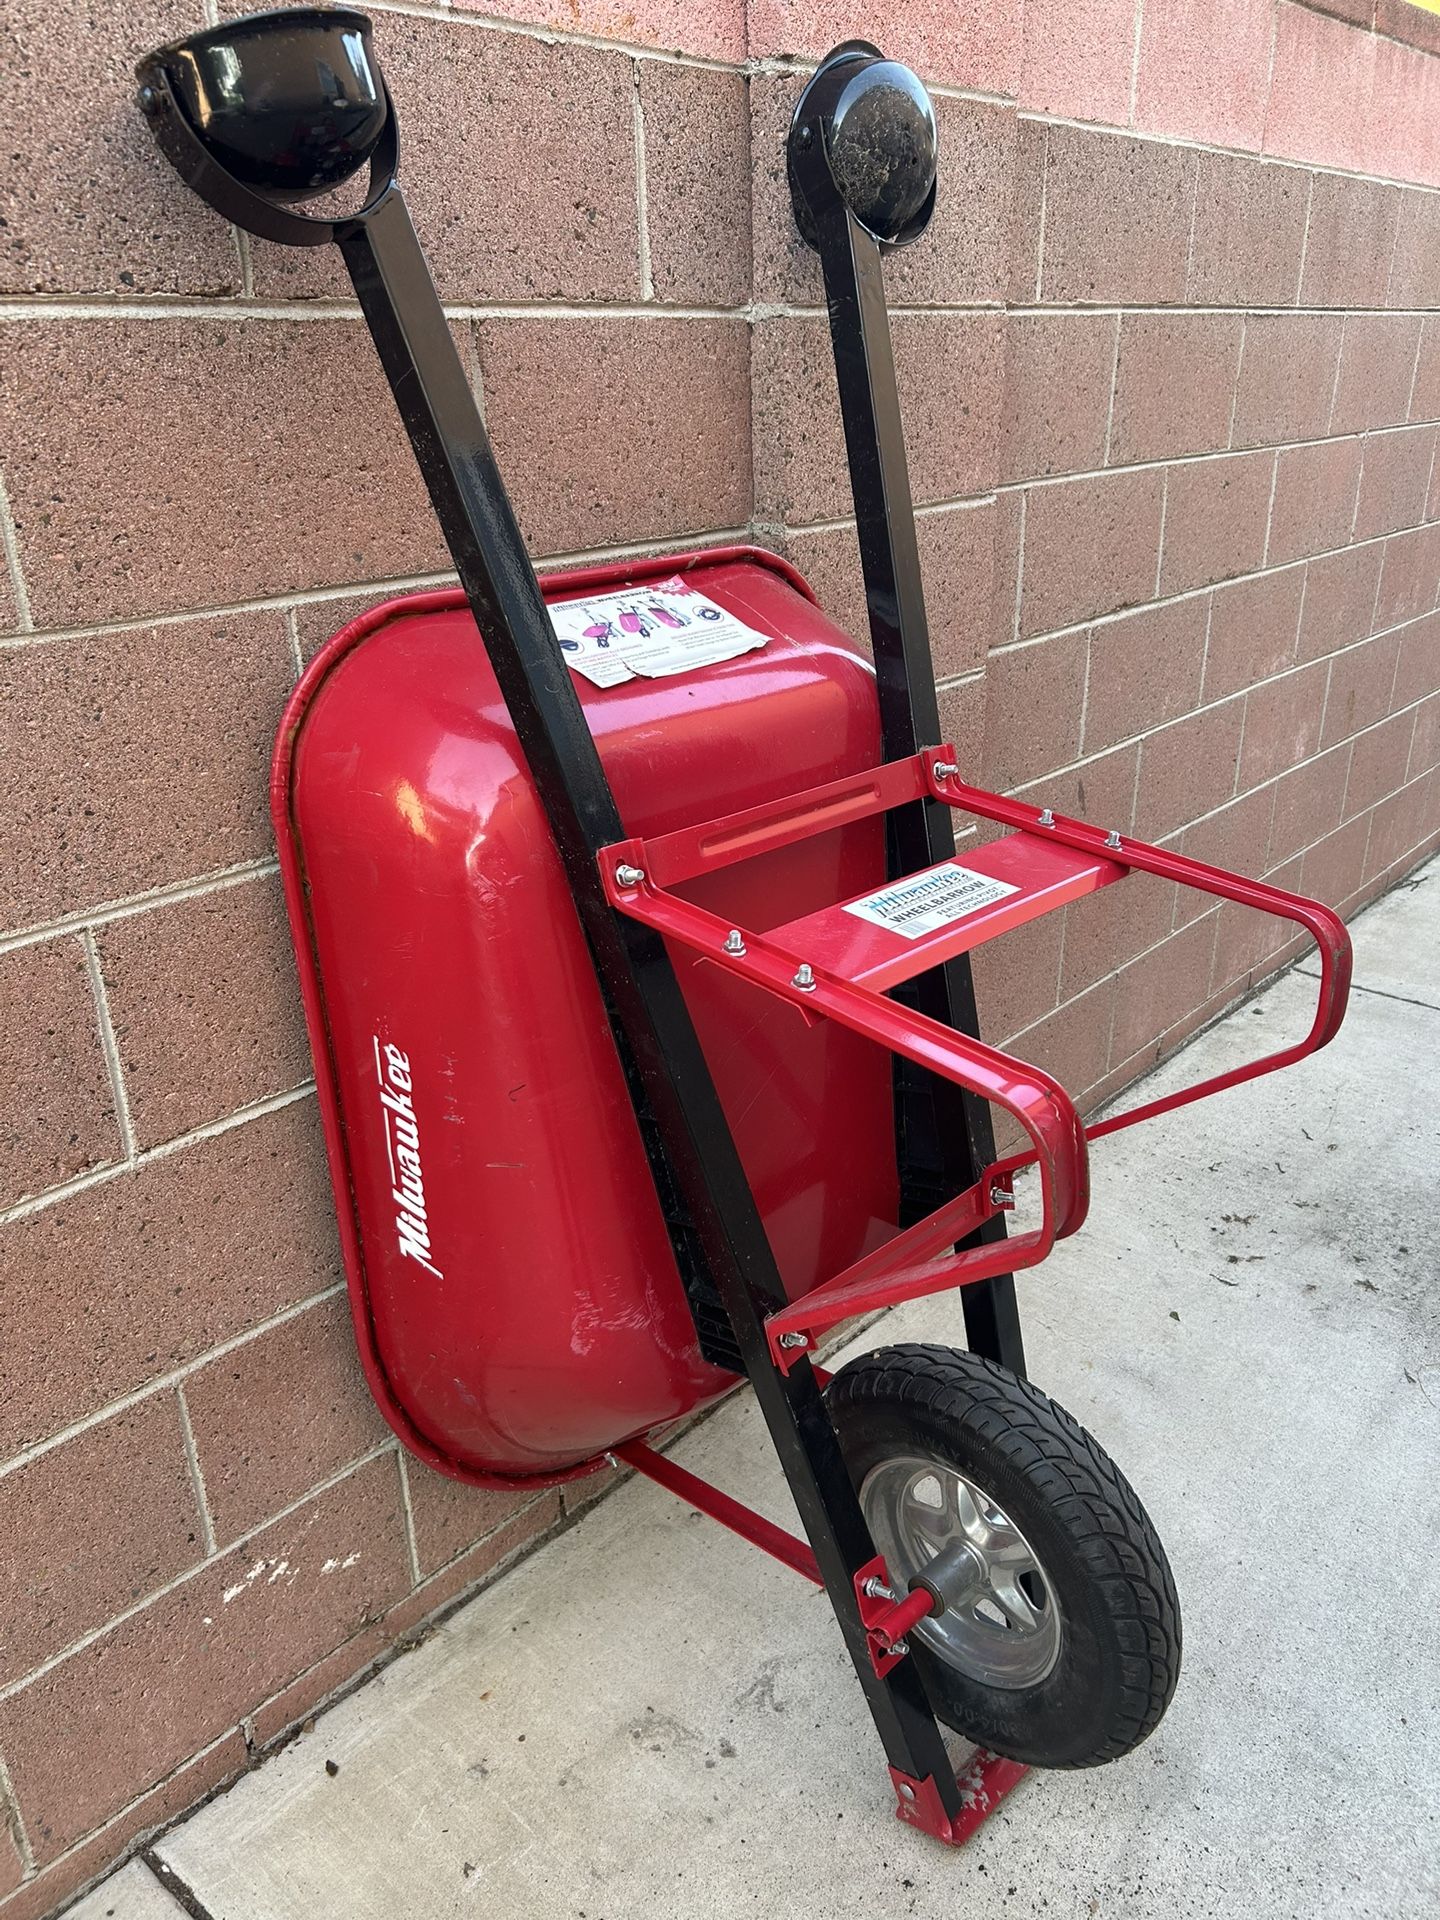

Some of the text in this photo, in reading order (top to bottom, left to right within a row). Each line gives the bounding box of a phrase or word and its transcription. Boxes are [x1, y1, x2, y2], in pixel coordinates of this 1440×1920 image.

[889, 880, 986, 923] WHEELBARROW
[937, 896, 978, 916] FEATURING
[946, 908, 961, 919] ALL
[961, 889, 1008, 913] TECHNOLOGY
[373, 1035, 444, 1281] Milwaukee
